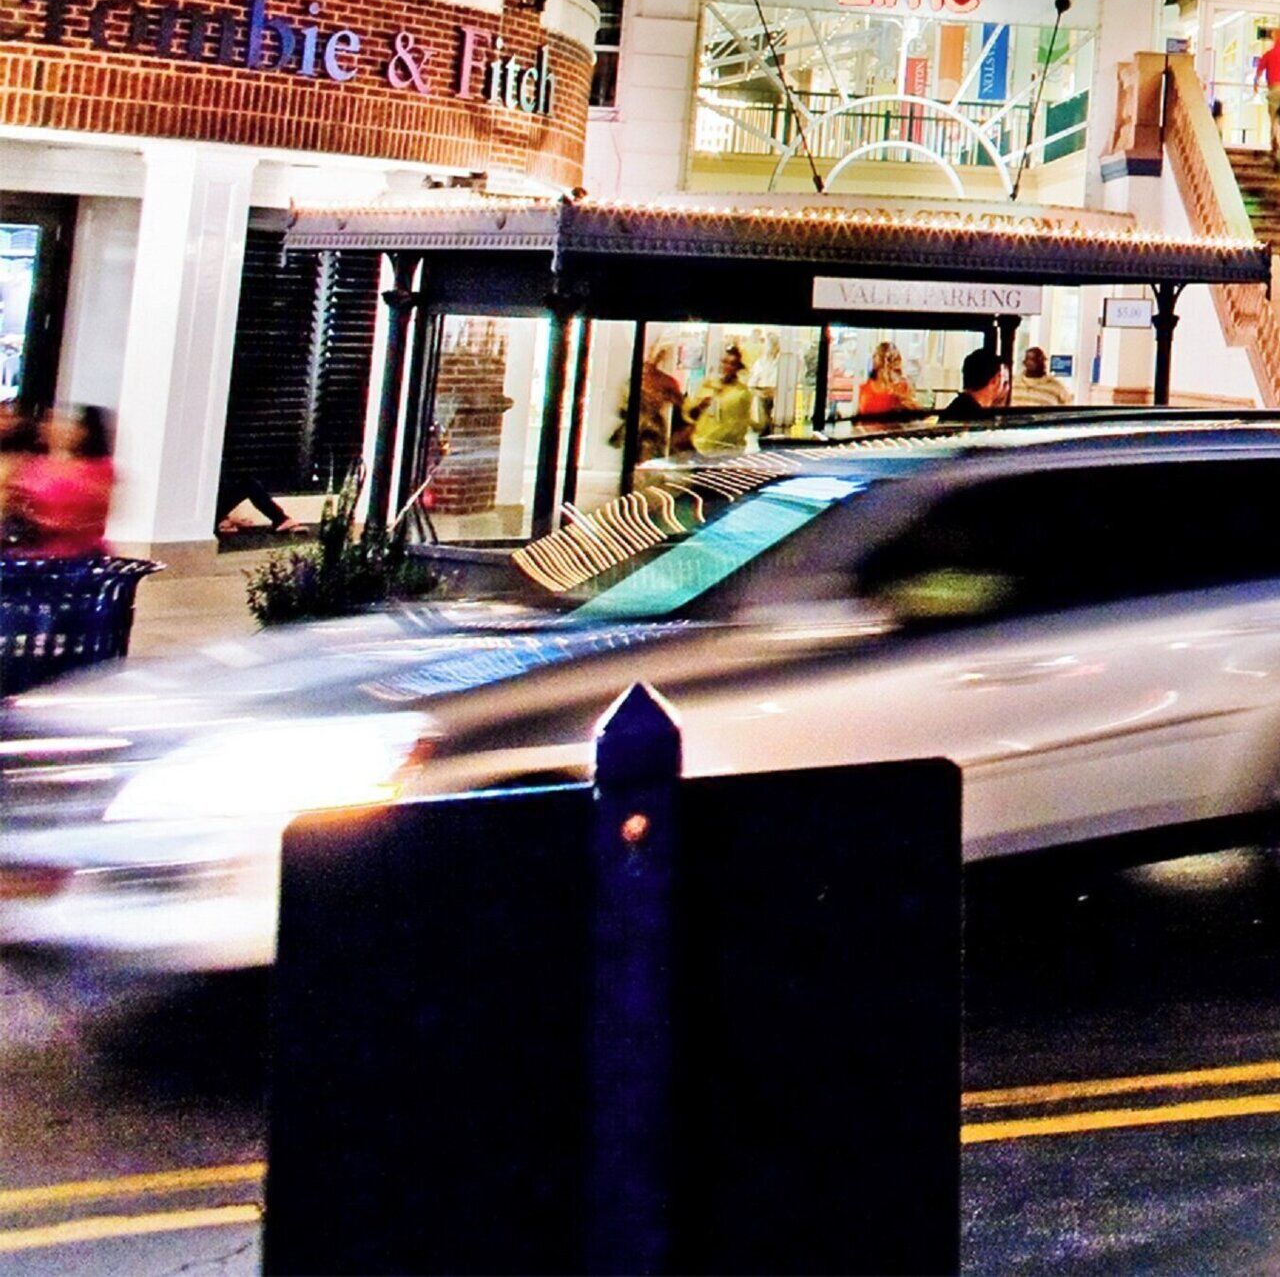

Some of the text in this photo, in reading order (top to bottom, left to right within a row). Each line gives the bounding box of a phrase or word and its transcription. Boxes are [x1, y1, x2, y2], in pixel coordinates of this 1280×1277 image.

[388, 30, 438, 95] &
[455, 25, 557, 118] Fitch
[838, 282, 1022, 309] VALET PARKING
